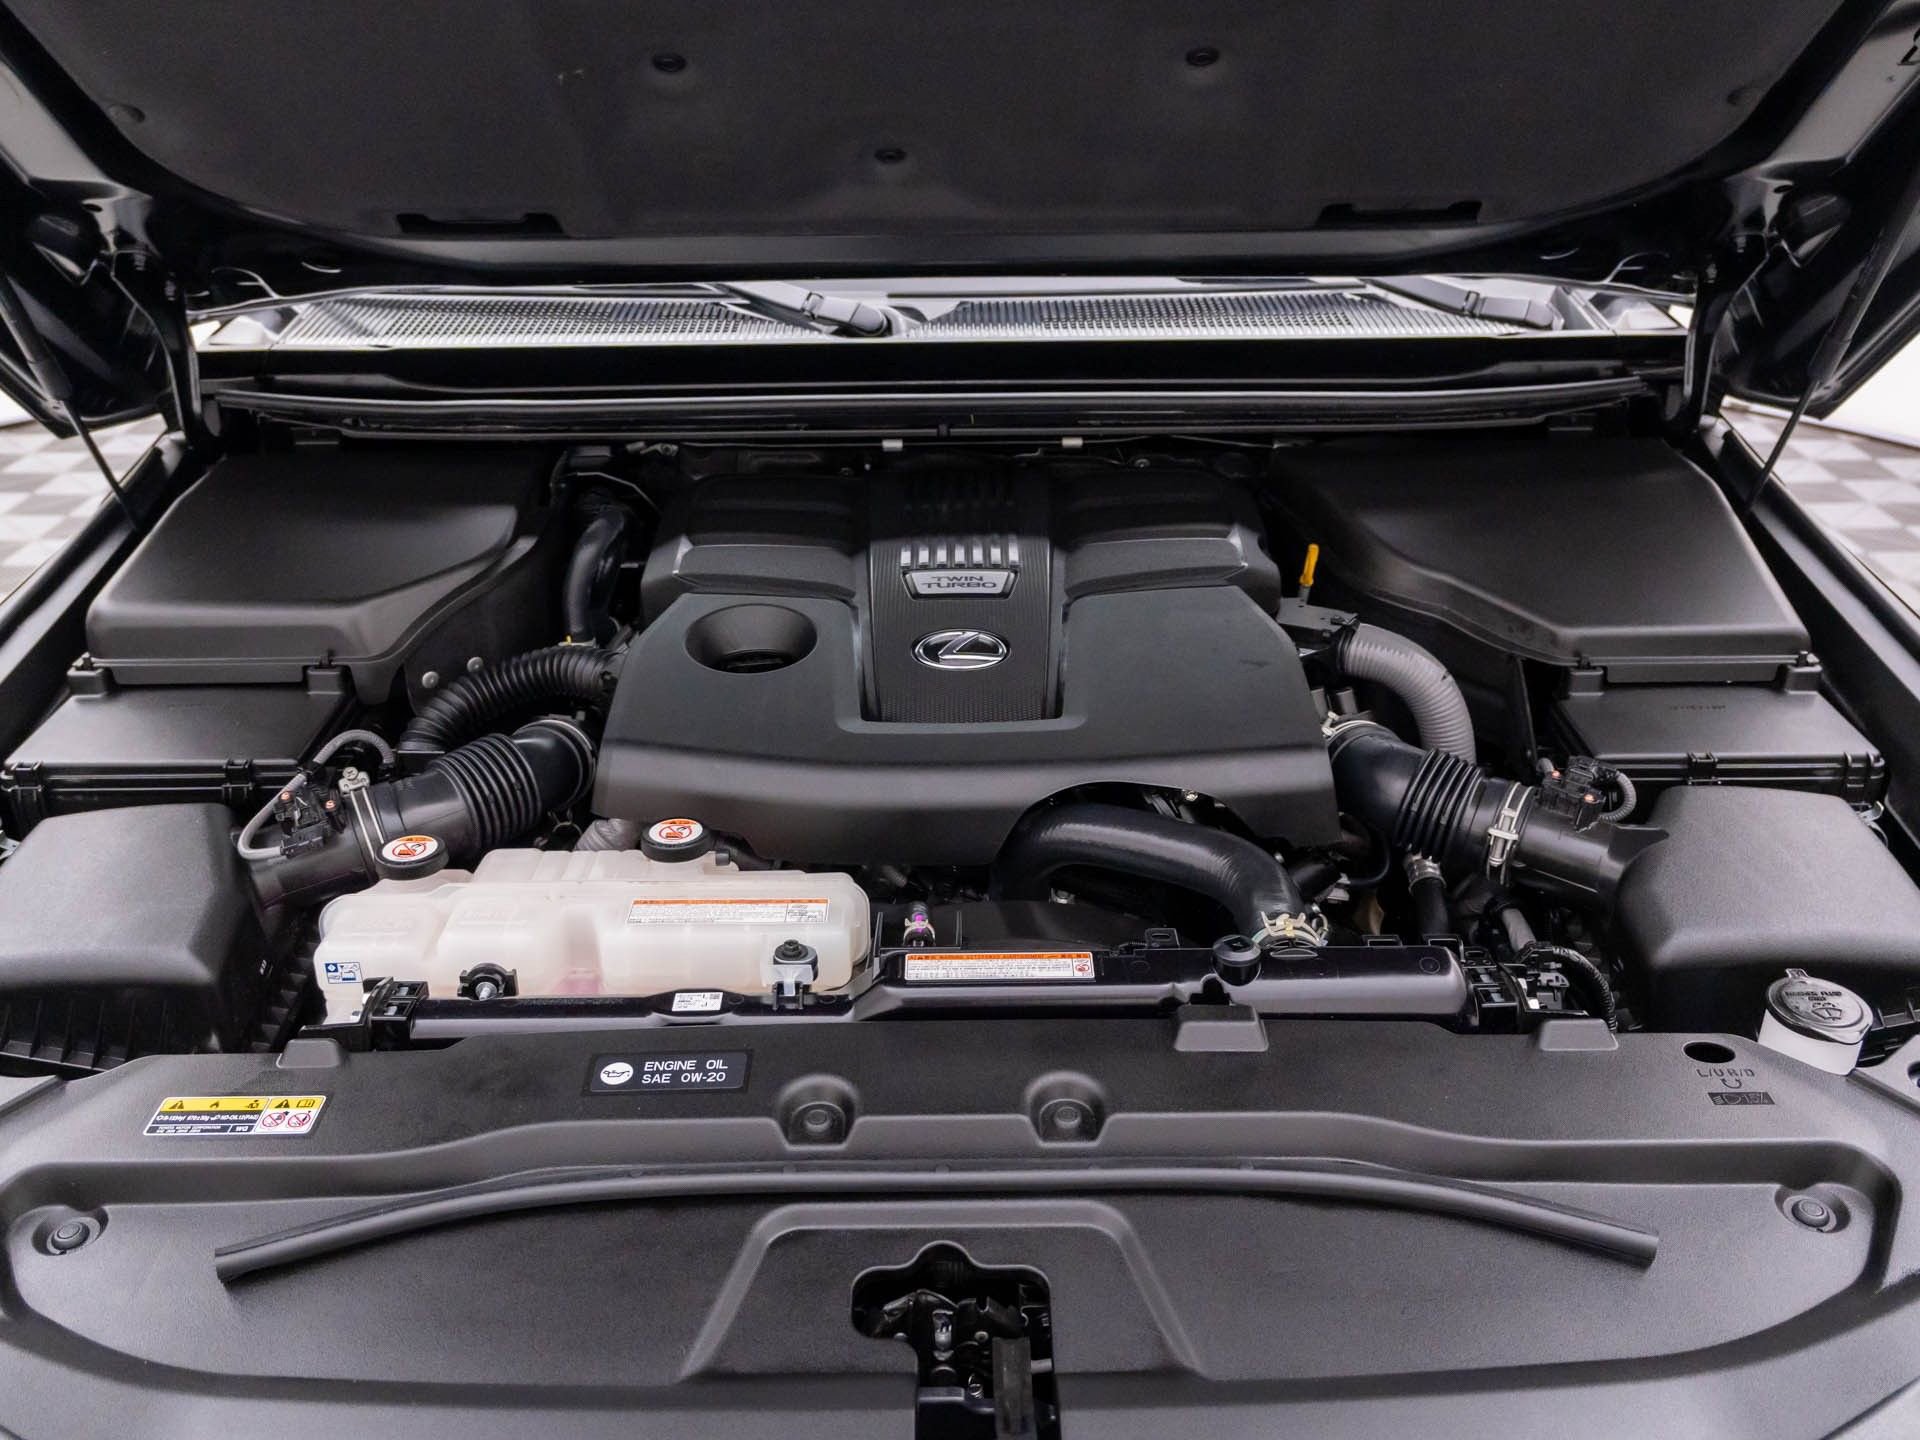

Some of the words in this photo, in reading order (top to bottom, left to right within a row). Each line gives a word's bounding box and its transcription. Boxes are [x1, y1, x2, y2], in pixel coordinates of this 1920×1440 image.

[920, 581, 998, 589] TURBO
[644, 1060, 697, 1071] ENGINE
[706, 1059, 729, 1070] OIL
[641, 1073, 672, 1084] SAE
[681, 1072, 726, 1083] 0W-20
